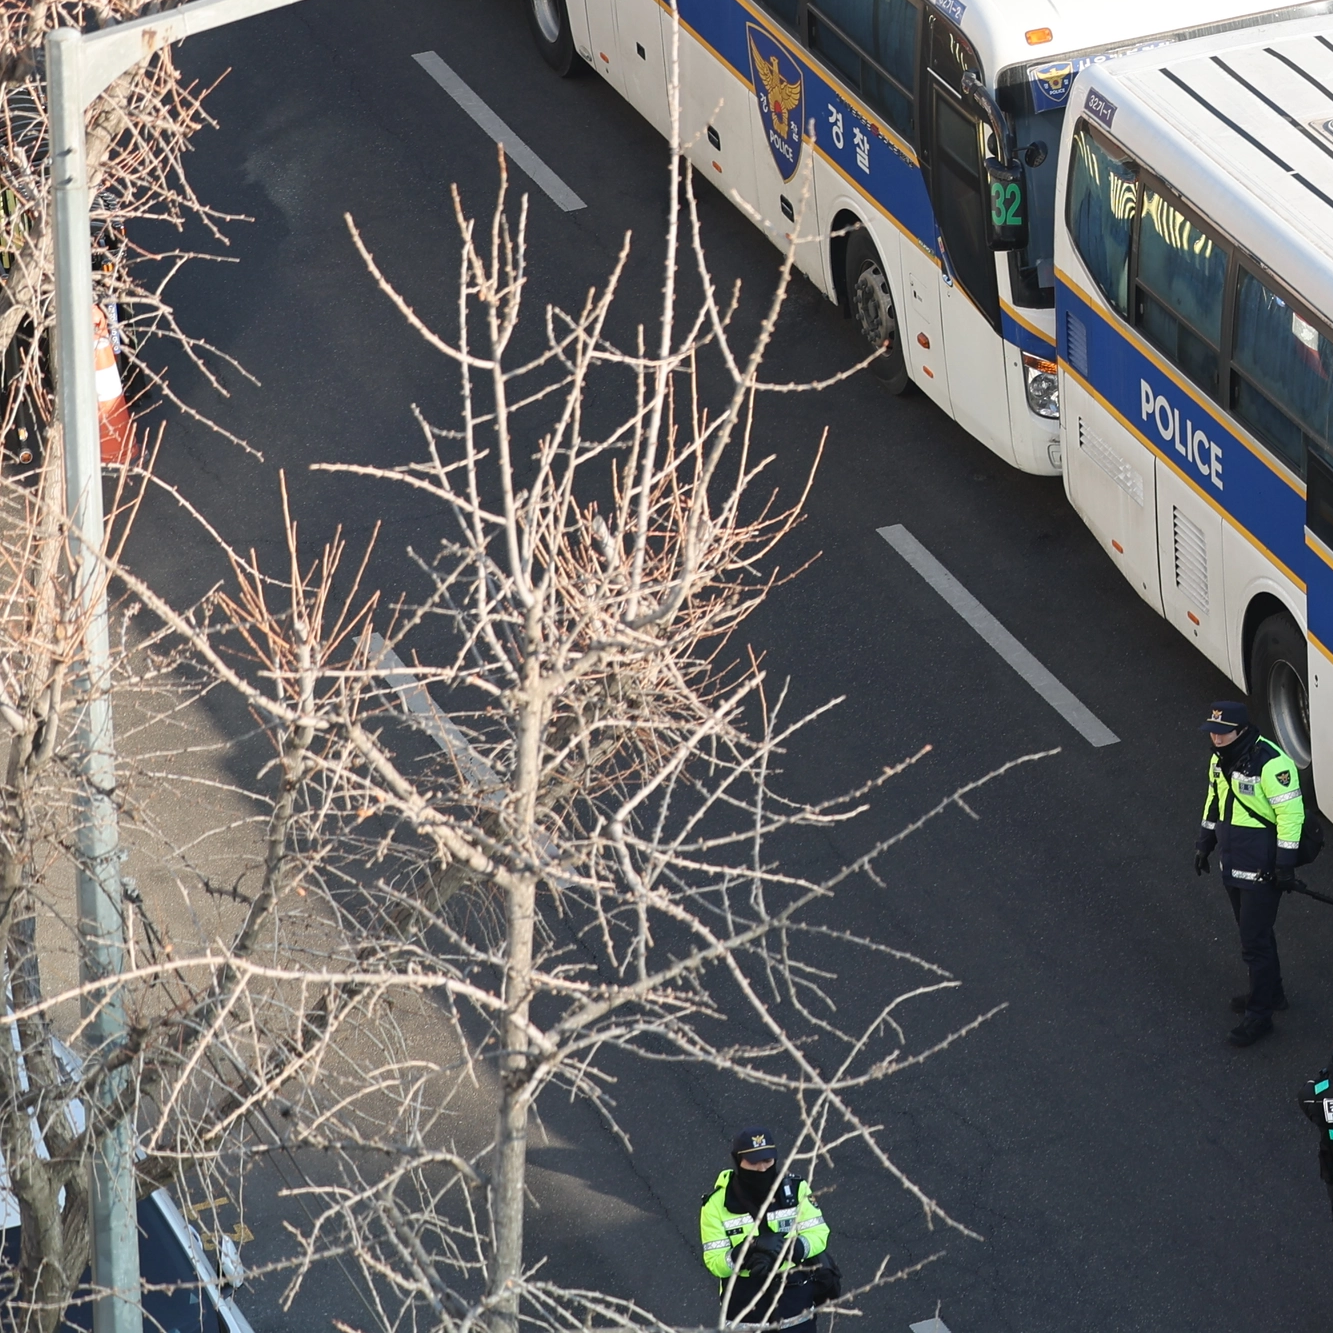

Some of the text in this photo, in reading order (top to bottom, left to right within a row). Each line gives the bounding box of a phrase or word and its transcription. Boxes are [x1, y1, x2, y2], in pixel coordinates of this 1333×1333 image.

[1049, 88, 1065, 96] POLICE
[1088, 94, 1110, 121] 32기-1
[768, 128, 794, 163] POLICE
[828, 104, 870, 174] 경찰
[990, 182, 1022, 226] 32
[1140, 379, 1224, 491] POLICE
